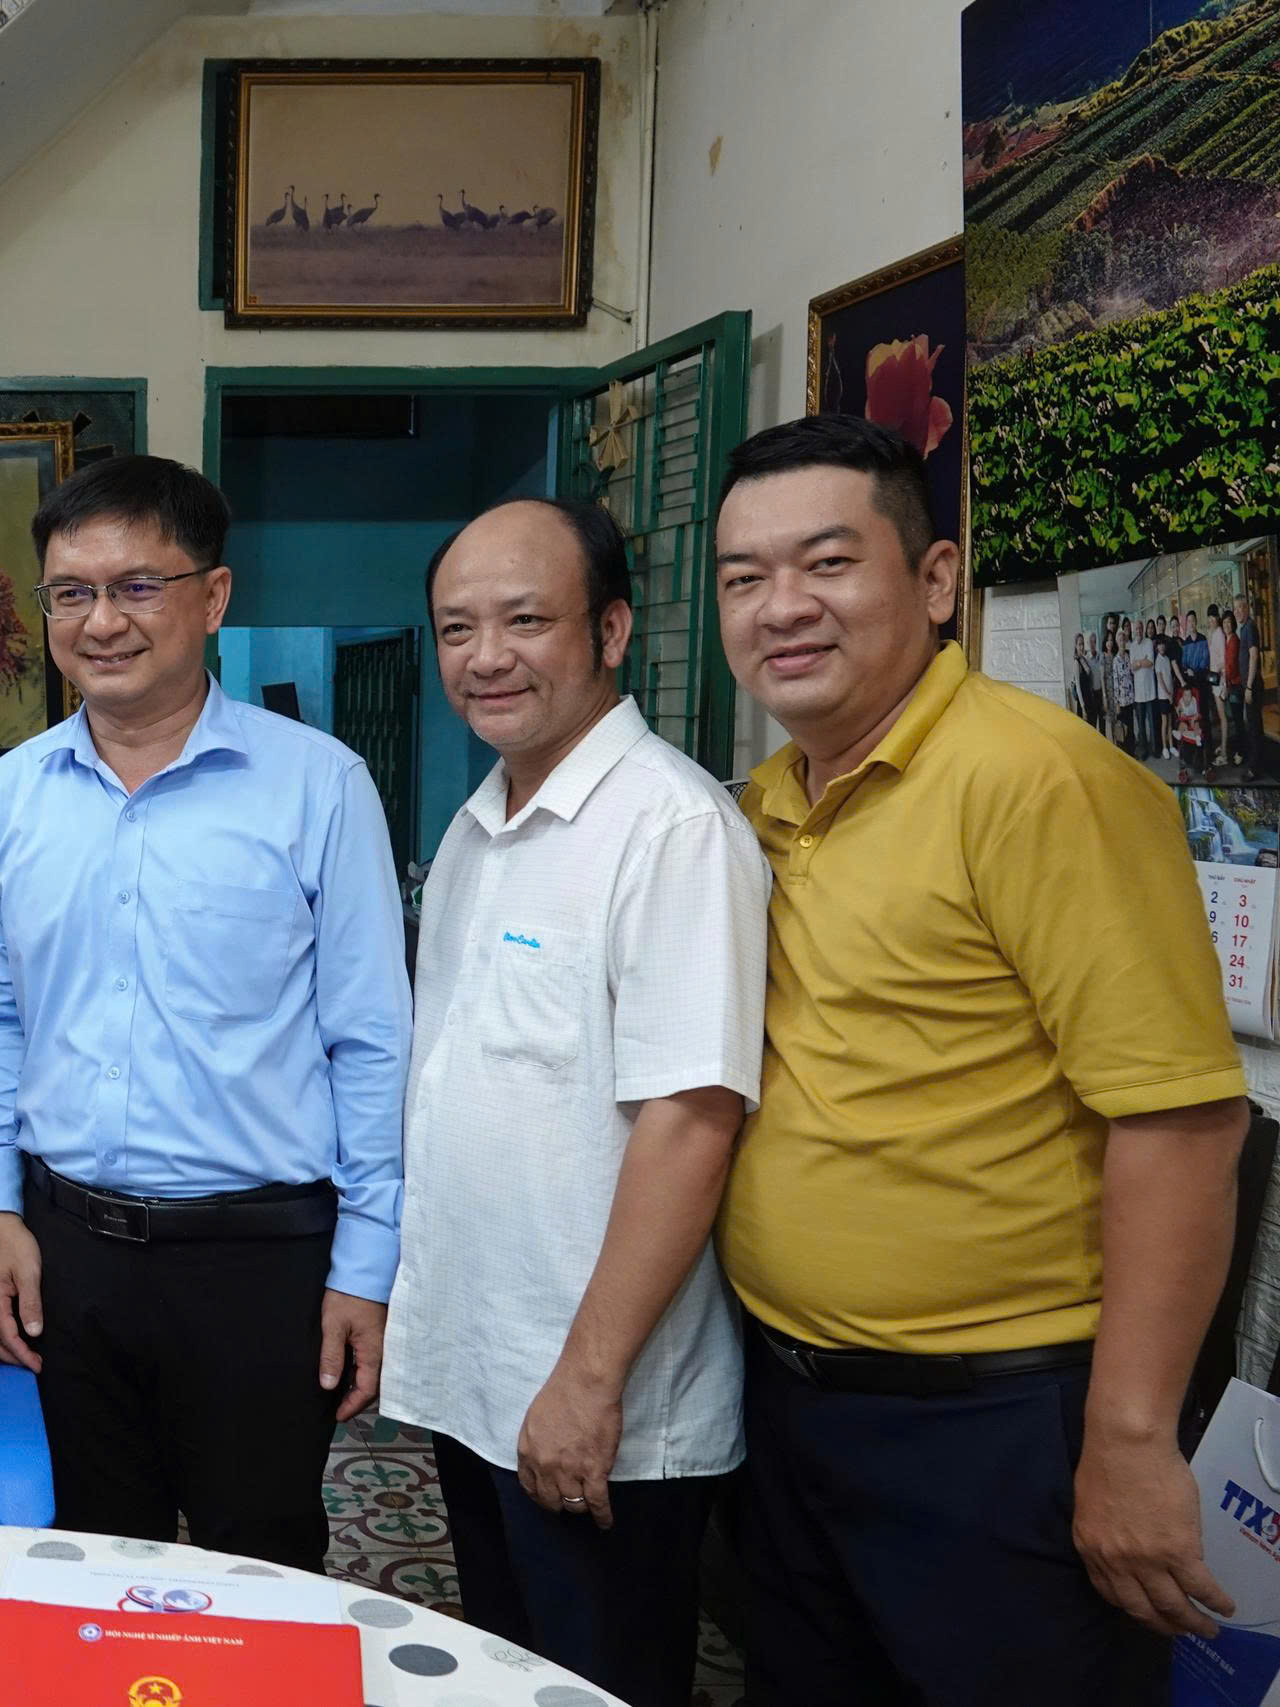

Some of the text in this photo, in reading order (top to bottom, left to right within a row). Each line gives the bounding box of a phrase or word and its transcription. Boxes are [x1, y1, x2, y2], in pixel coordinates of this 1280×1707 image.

[1211, 891, 1247, 907] 2 3
[1209, 911, 1249, 928] 9 10
[1232, 934, 1248, 948] 17
[1230, 954, 1245, 968] 24
[1229, 974, 1243, 988] 31
[224, 1637, 244, 1645] NAM
